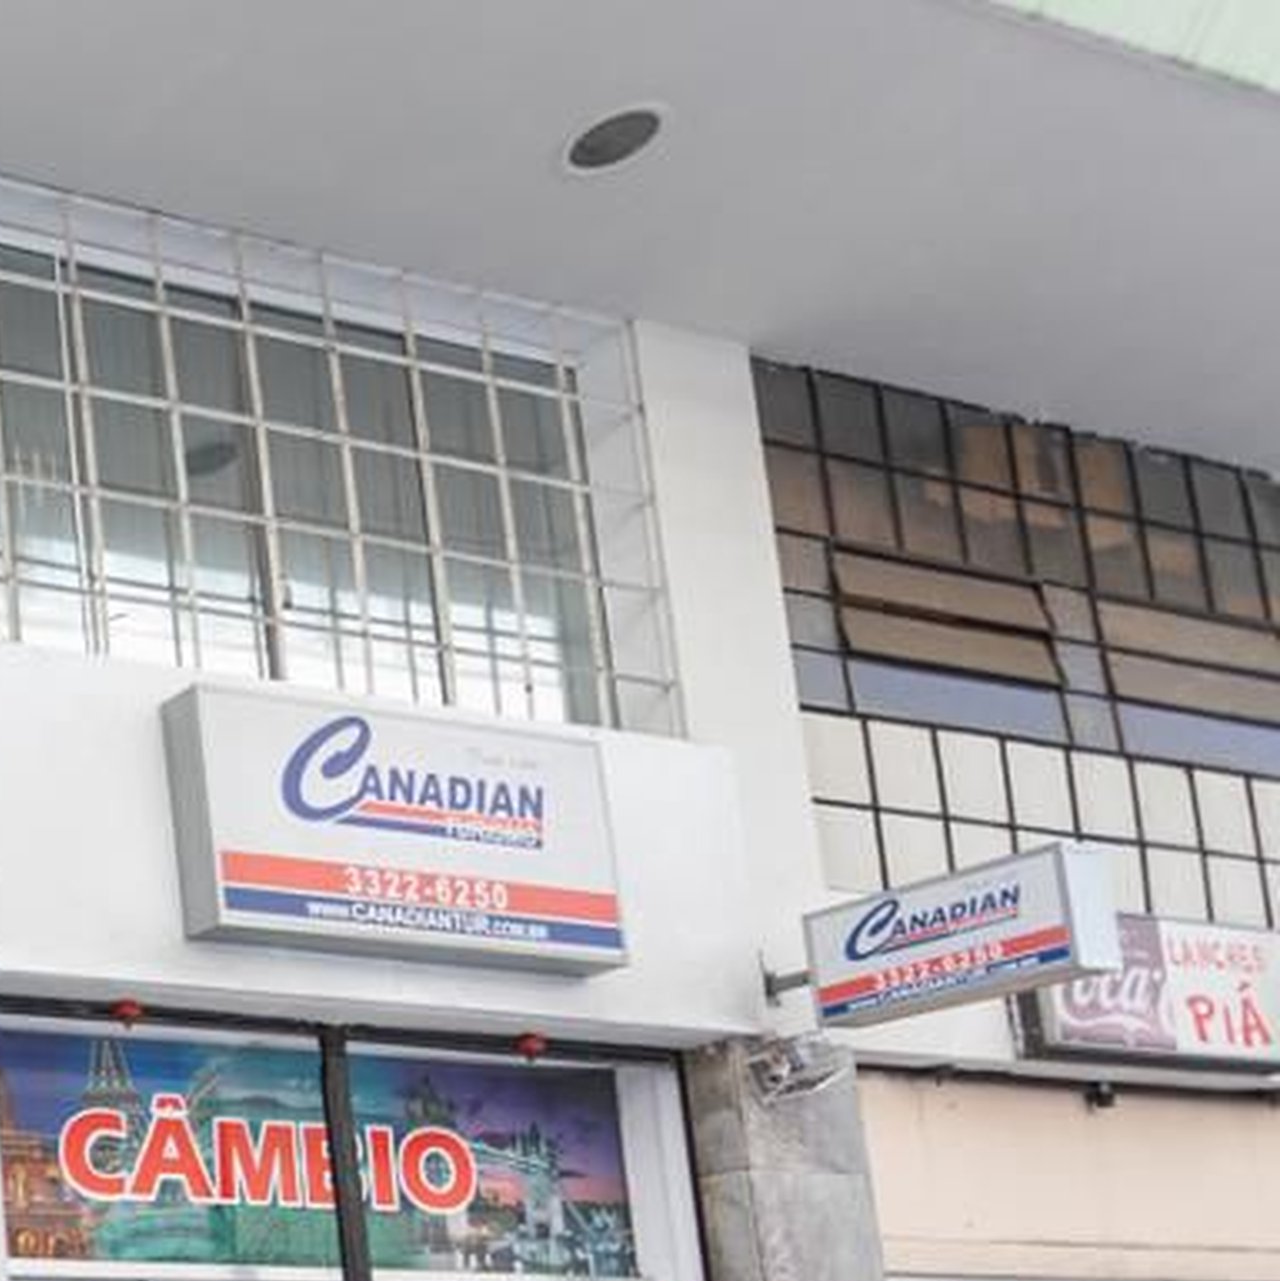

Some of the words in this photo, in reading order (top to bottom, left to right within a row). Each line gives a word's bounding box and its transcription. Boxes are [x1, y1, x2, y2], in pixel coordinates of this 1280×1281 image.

[281, 716, 544, 824] CANADIAN
[345, 866, 509, 910] 3322-6250
[845, 883, 1021, 961] CANADIAN
